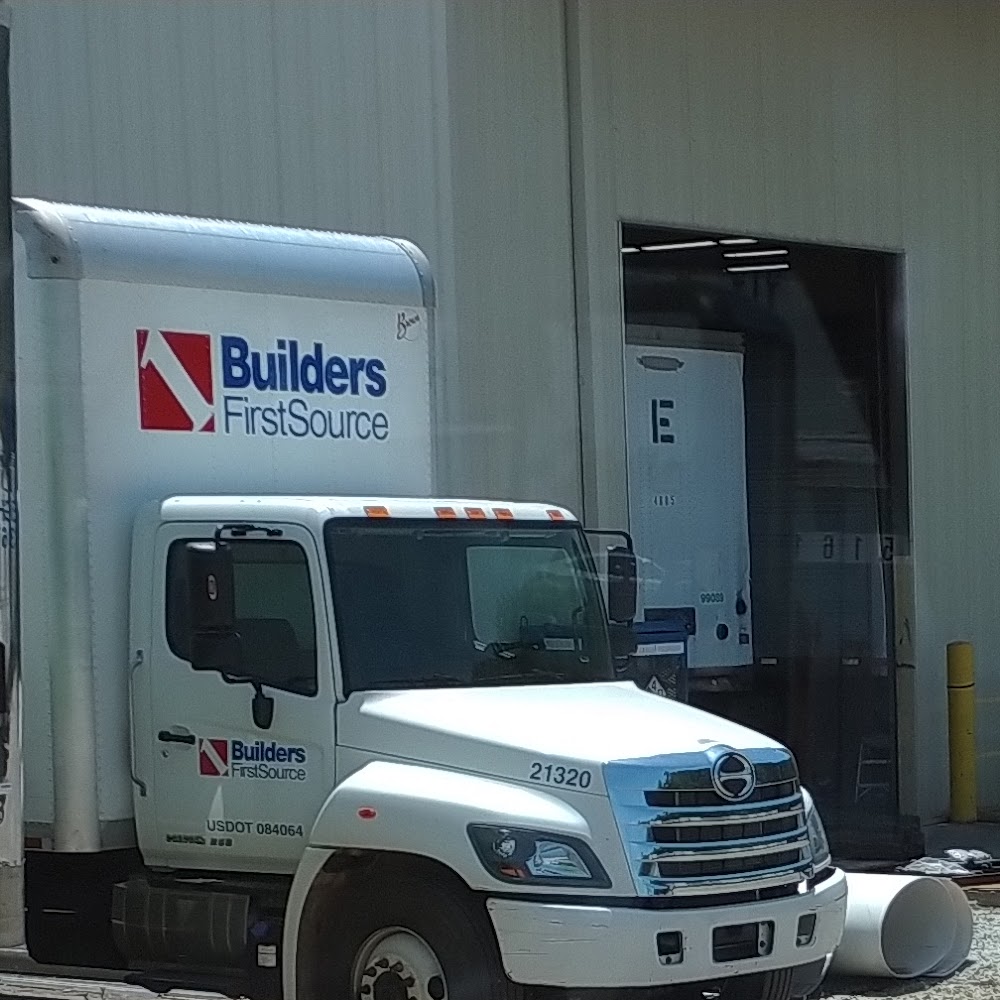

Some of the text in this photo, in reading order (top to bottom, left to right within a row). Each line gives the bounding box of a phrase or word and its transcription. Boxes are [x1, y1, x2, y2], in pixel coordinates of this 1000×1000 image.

[220, 335, 387, 398] Builders
[223, 395, 389, 440] FirstSource
[651, 399, 675, 444] E
[231, 740, 306, 763] Builders
[231, 763, 306, 781] FirstSource
[529, 762, 592, 788] 21320
[206, 819, 303, 837] USDOT 084064
